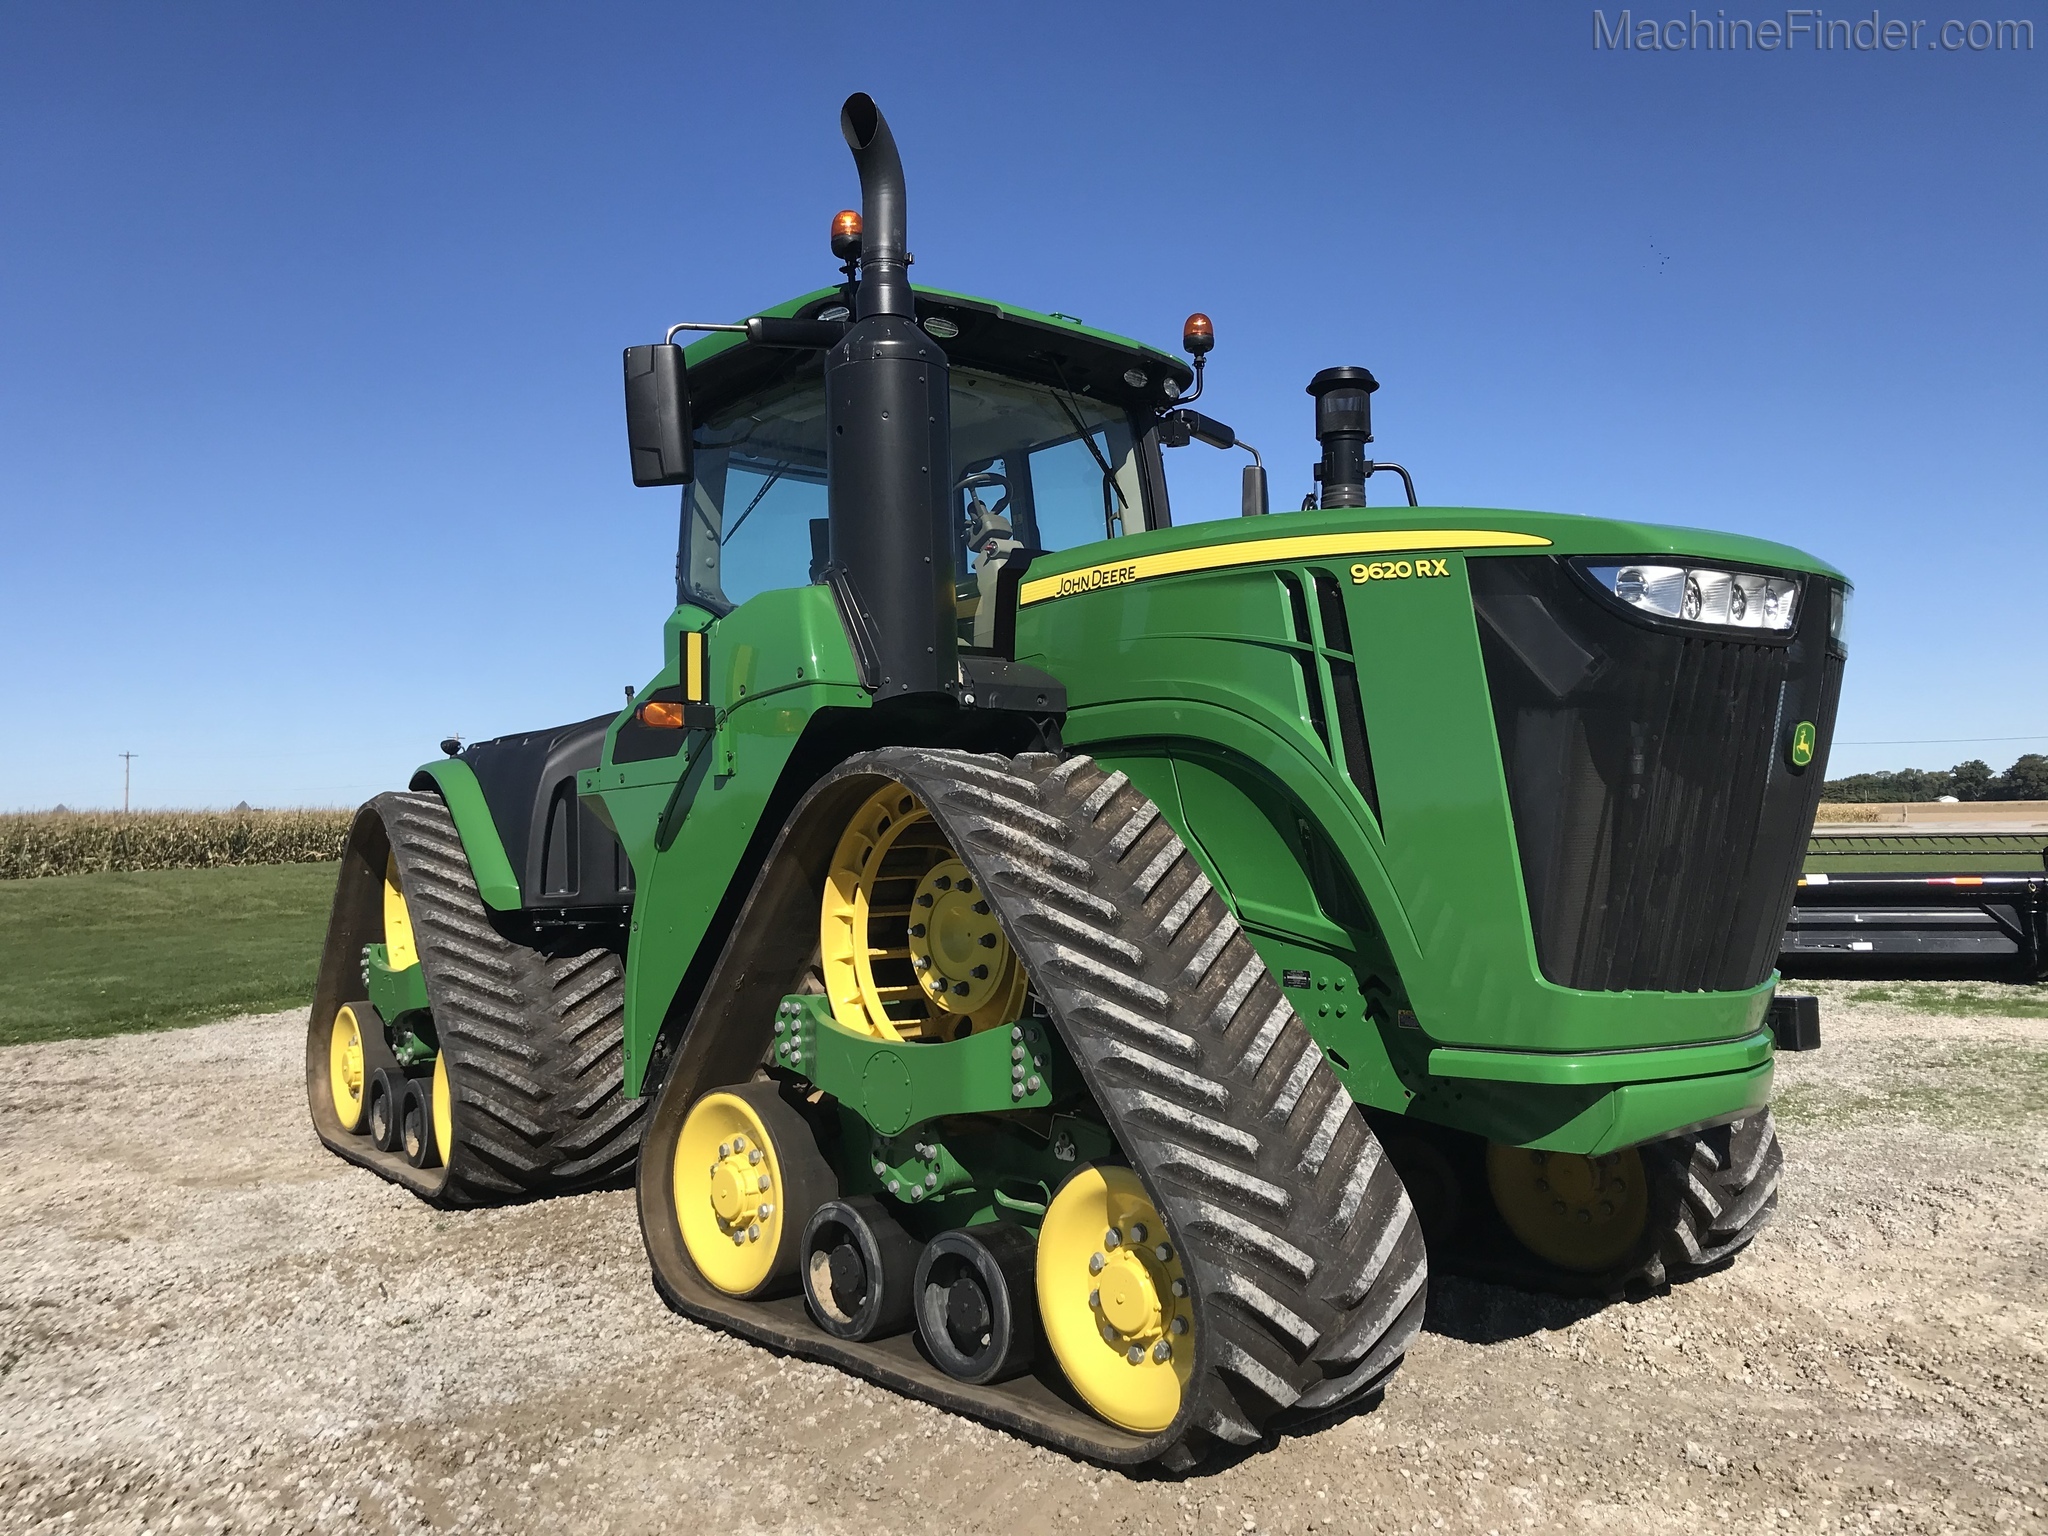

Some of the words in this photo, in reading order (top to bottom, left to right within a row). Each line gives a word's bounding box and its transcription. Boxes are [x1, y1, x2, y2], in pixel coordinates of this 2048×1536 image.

[1055, 574, 1090, 596] JOHN
[1091, 565, 1137, 588] DEERE
[1349, 561, 1413, 585] 9620
[1414, 558, 1451, 578] RX
